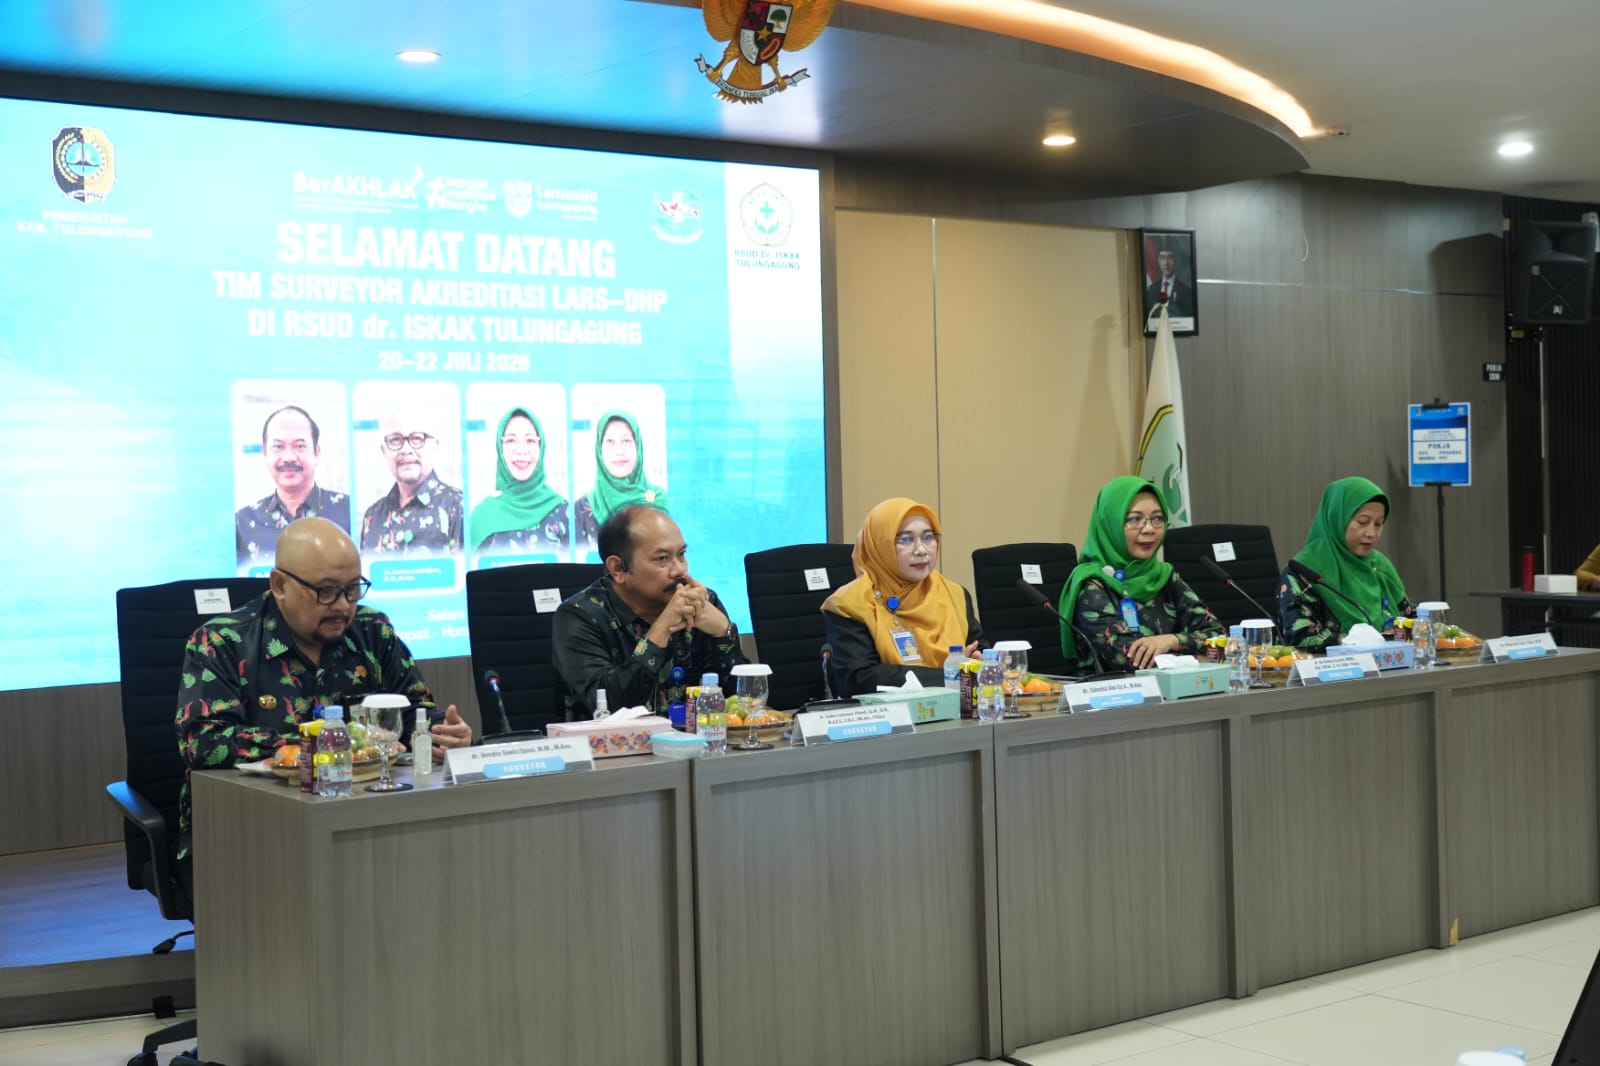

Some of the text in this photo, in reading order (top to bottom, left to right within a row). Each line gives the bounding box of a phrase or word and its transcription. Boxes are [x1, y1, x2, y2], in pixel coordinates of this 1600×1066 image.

[292, 170, 418, 201] BerAKHLAK
[276, 220, 616, 279] SELAMAT DATANG
[736, 258, 801, 270] TULUNGAGUNG
[211, 269, 263, 299] TIM
[269, 272, 404, 305] SURVEYOR
[409, 278, 546, 309] AKREDITASI
[247, 308, 643, 346] DI RSUD dr. ISKAK TULUNGAGUNG
[443, 351, 482, 372] JULI
[427, 608, 465, 622] Salam
